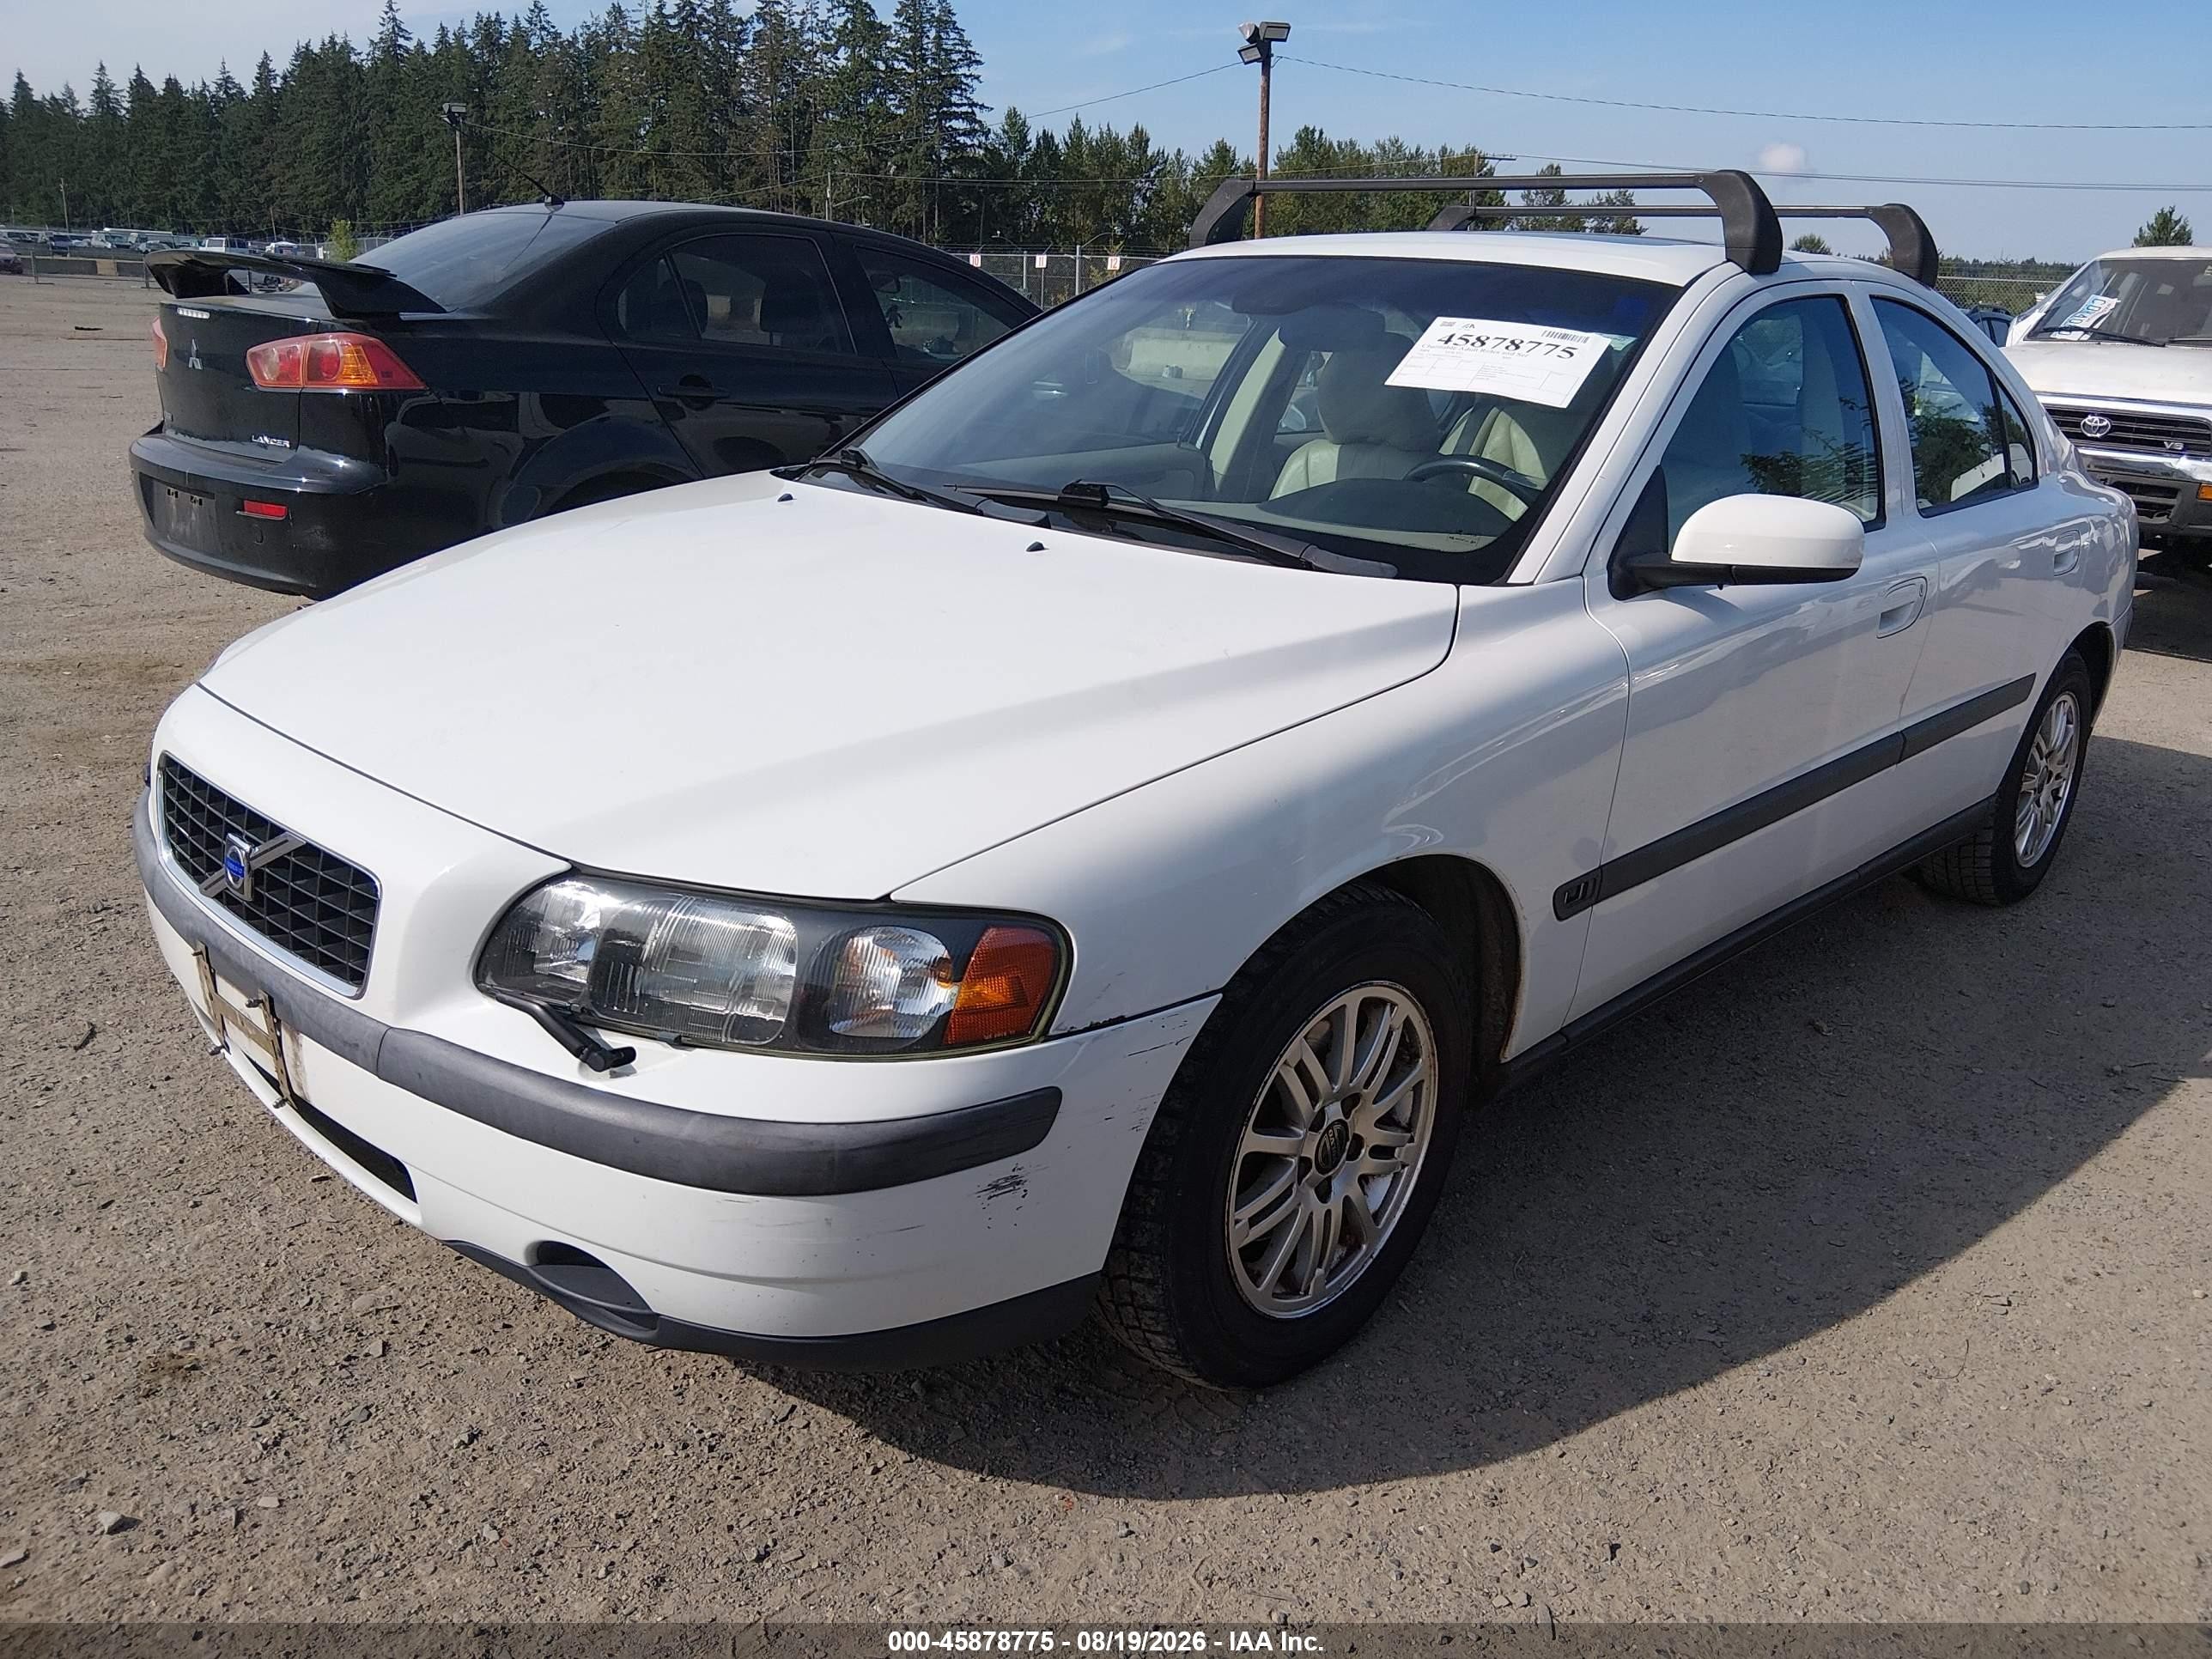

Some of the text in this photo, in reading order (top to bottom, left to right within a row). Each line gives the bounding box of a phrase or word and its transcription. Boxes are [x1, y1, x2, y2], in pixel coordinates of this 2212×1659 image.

[971, 256, 980, 266] 10
[1038, 256, 1044, 267] 11
[1110, 258, 1118, 269] 12
[1437, 332, 1579, 360] 45878775
[252, 434, 290, 447] LANCER
